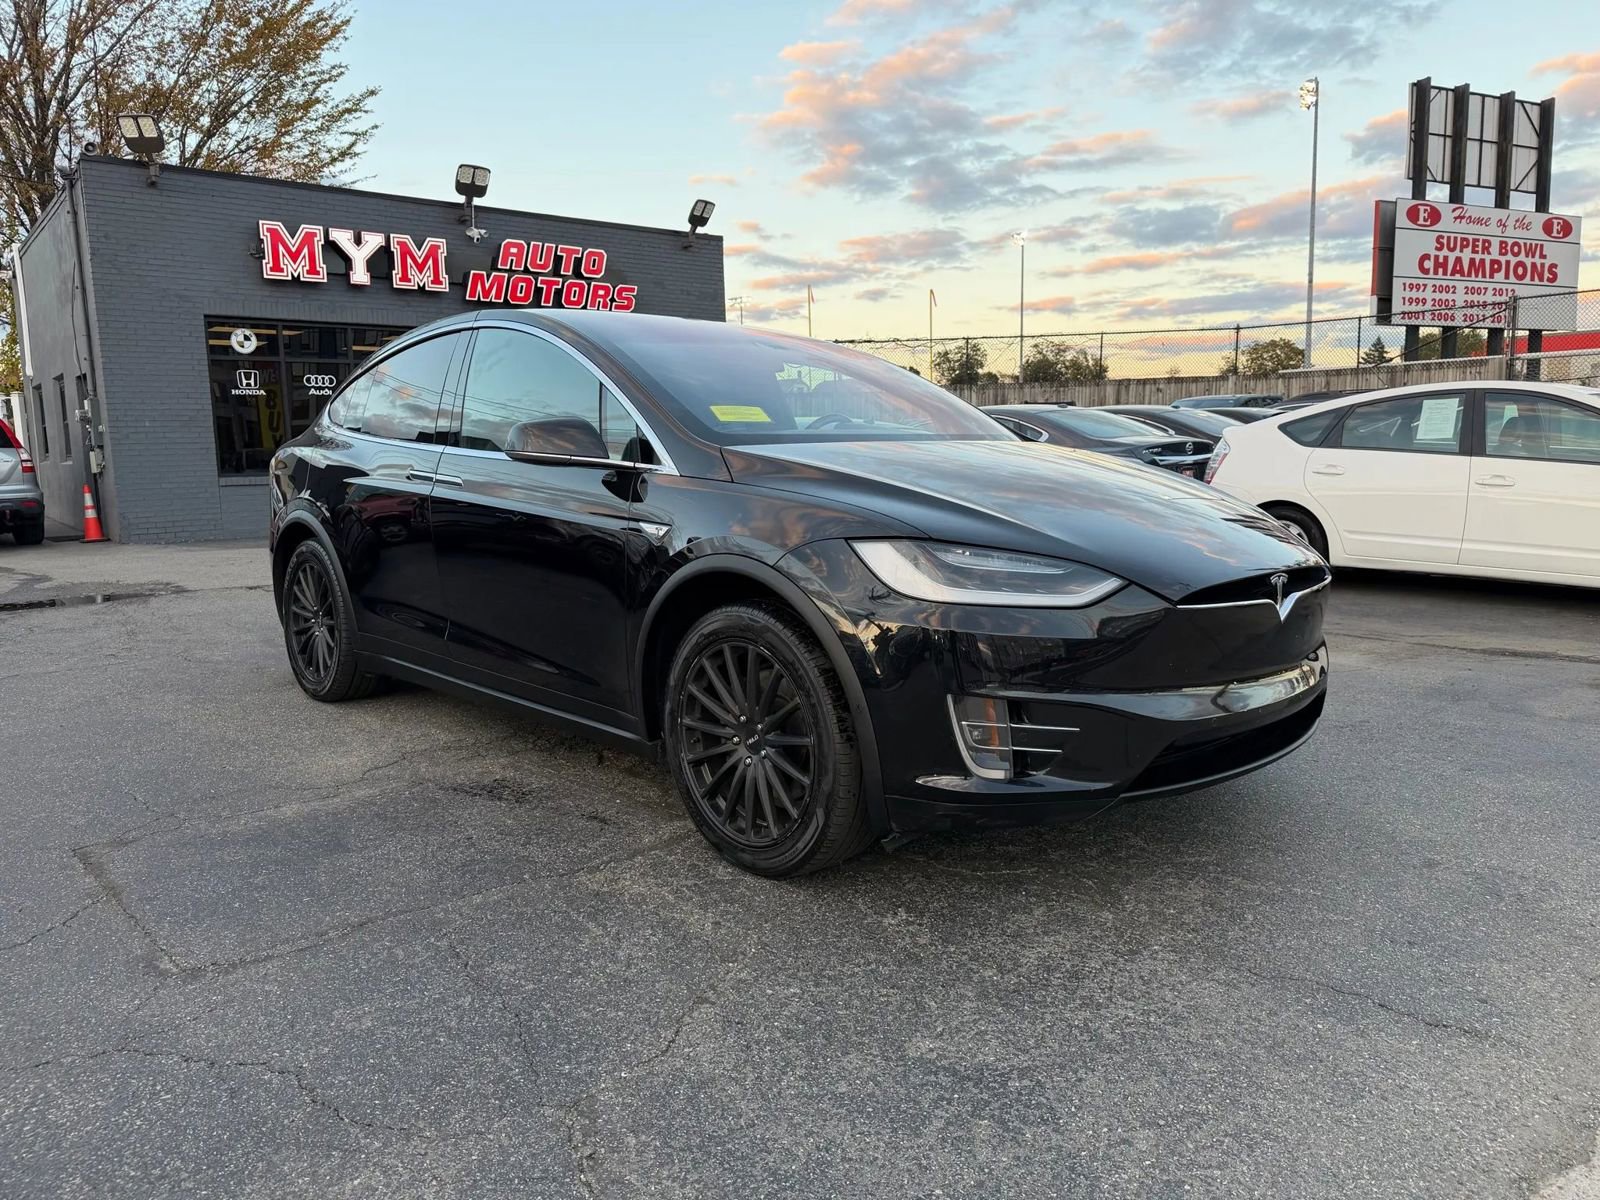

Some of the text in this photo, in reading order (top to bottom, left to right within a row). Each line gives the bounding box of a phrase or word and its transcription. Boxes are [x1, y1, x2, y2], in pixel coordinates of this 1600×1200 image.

[1417, 205, 1431, 225] E
[1451, 206, 1533, 234] Home of the
[1551, 219, 1564, 237] E
[258, 219, 449, 292] MYM
[497, 238, 607, 278] AUTO
[1434, 234, 1548, 260] SUPER BOWL
[1417, 253, 1559, 284] CHAMPIONS
[465, 269, 639, 313] MOTORS
[1402, 282, 1428, 293] 1997
[1431, 284, 1457, 294] 2002
[1464, 286, 1489, 296] 2007
[1401, 297, 1428, 307] 1999
[1431, 298, 1457, 308] 2003
[308, 388, 333, 396] Audi
